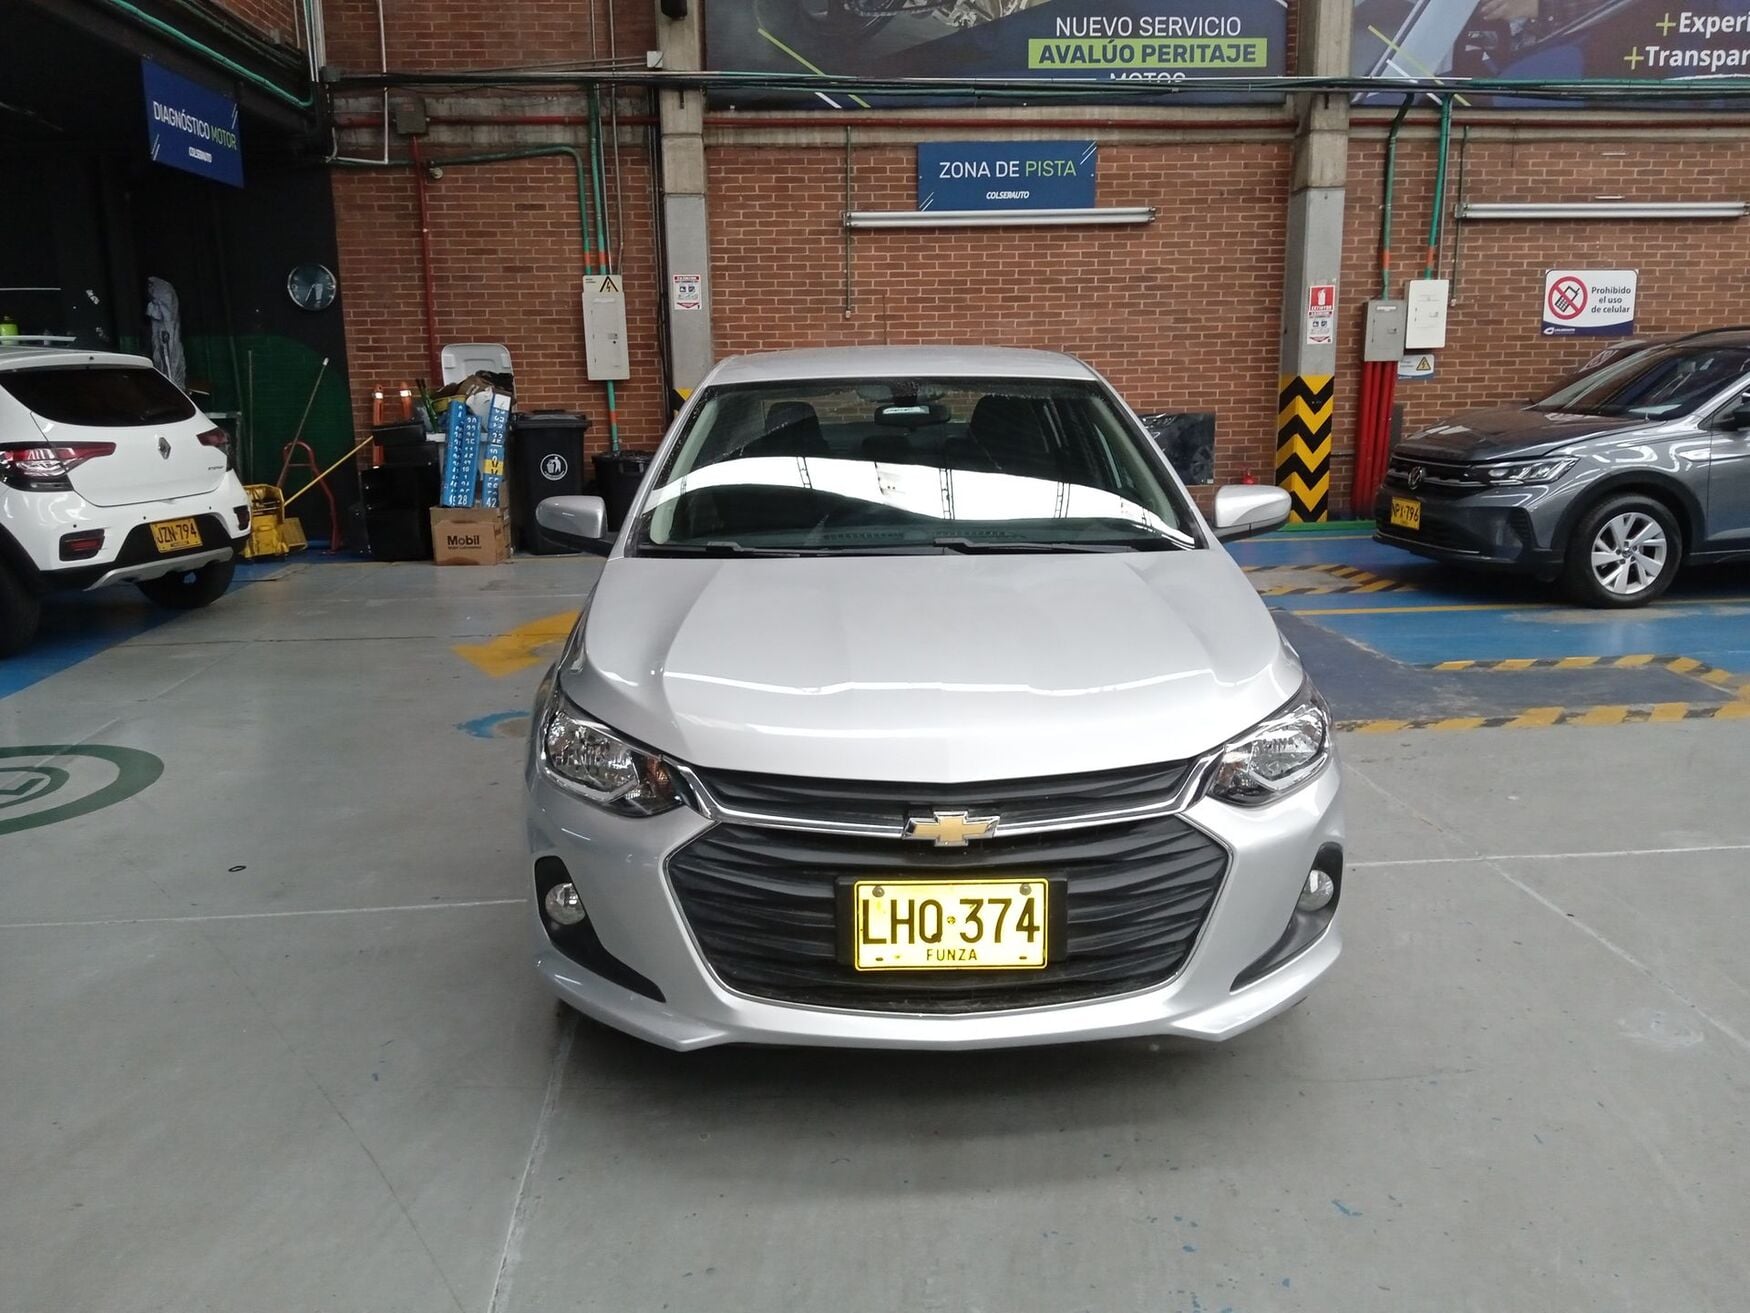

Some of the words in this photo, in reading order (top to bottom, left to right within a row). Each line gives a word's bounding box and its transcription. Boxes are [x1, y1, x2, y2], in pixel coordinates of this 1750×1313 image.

[1056, 16, 1133, 37] NUEVO
[1139, 16, 1242, 37] SERVICIO
[1038, 38, 1136, 64] AVALÚO
[1141, 43, 1257, 63] PERITAJE
[153, 101, 210, 140] DIAGNÓSTICO
[210, 125, 238, 150] MOTOR
[939, 161, 991, 178] ZONA
[995, 160, 1020, 177] DE
[1025, 160, 1077, 177] PISTA
[1591, 286, 1632, 294] Prohibido
[1591, 305, 1601, 313] de
[1602, 305, 1630, 313] celular
[447, 535, 480, 546] Mobil
[926, 948, 978, 961] FUNZA
